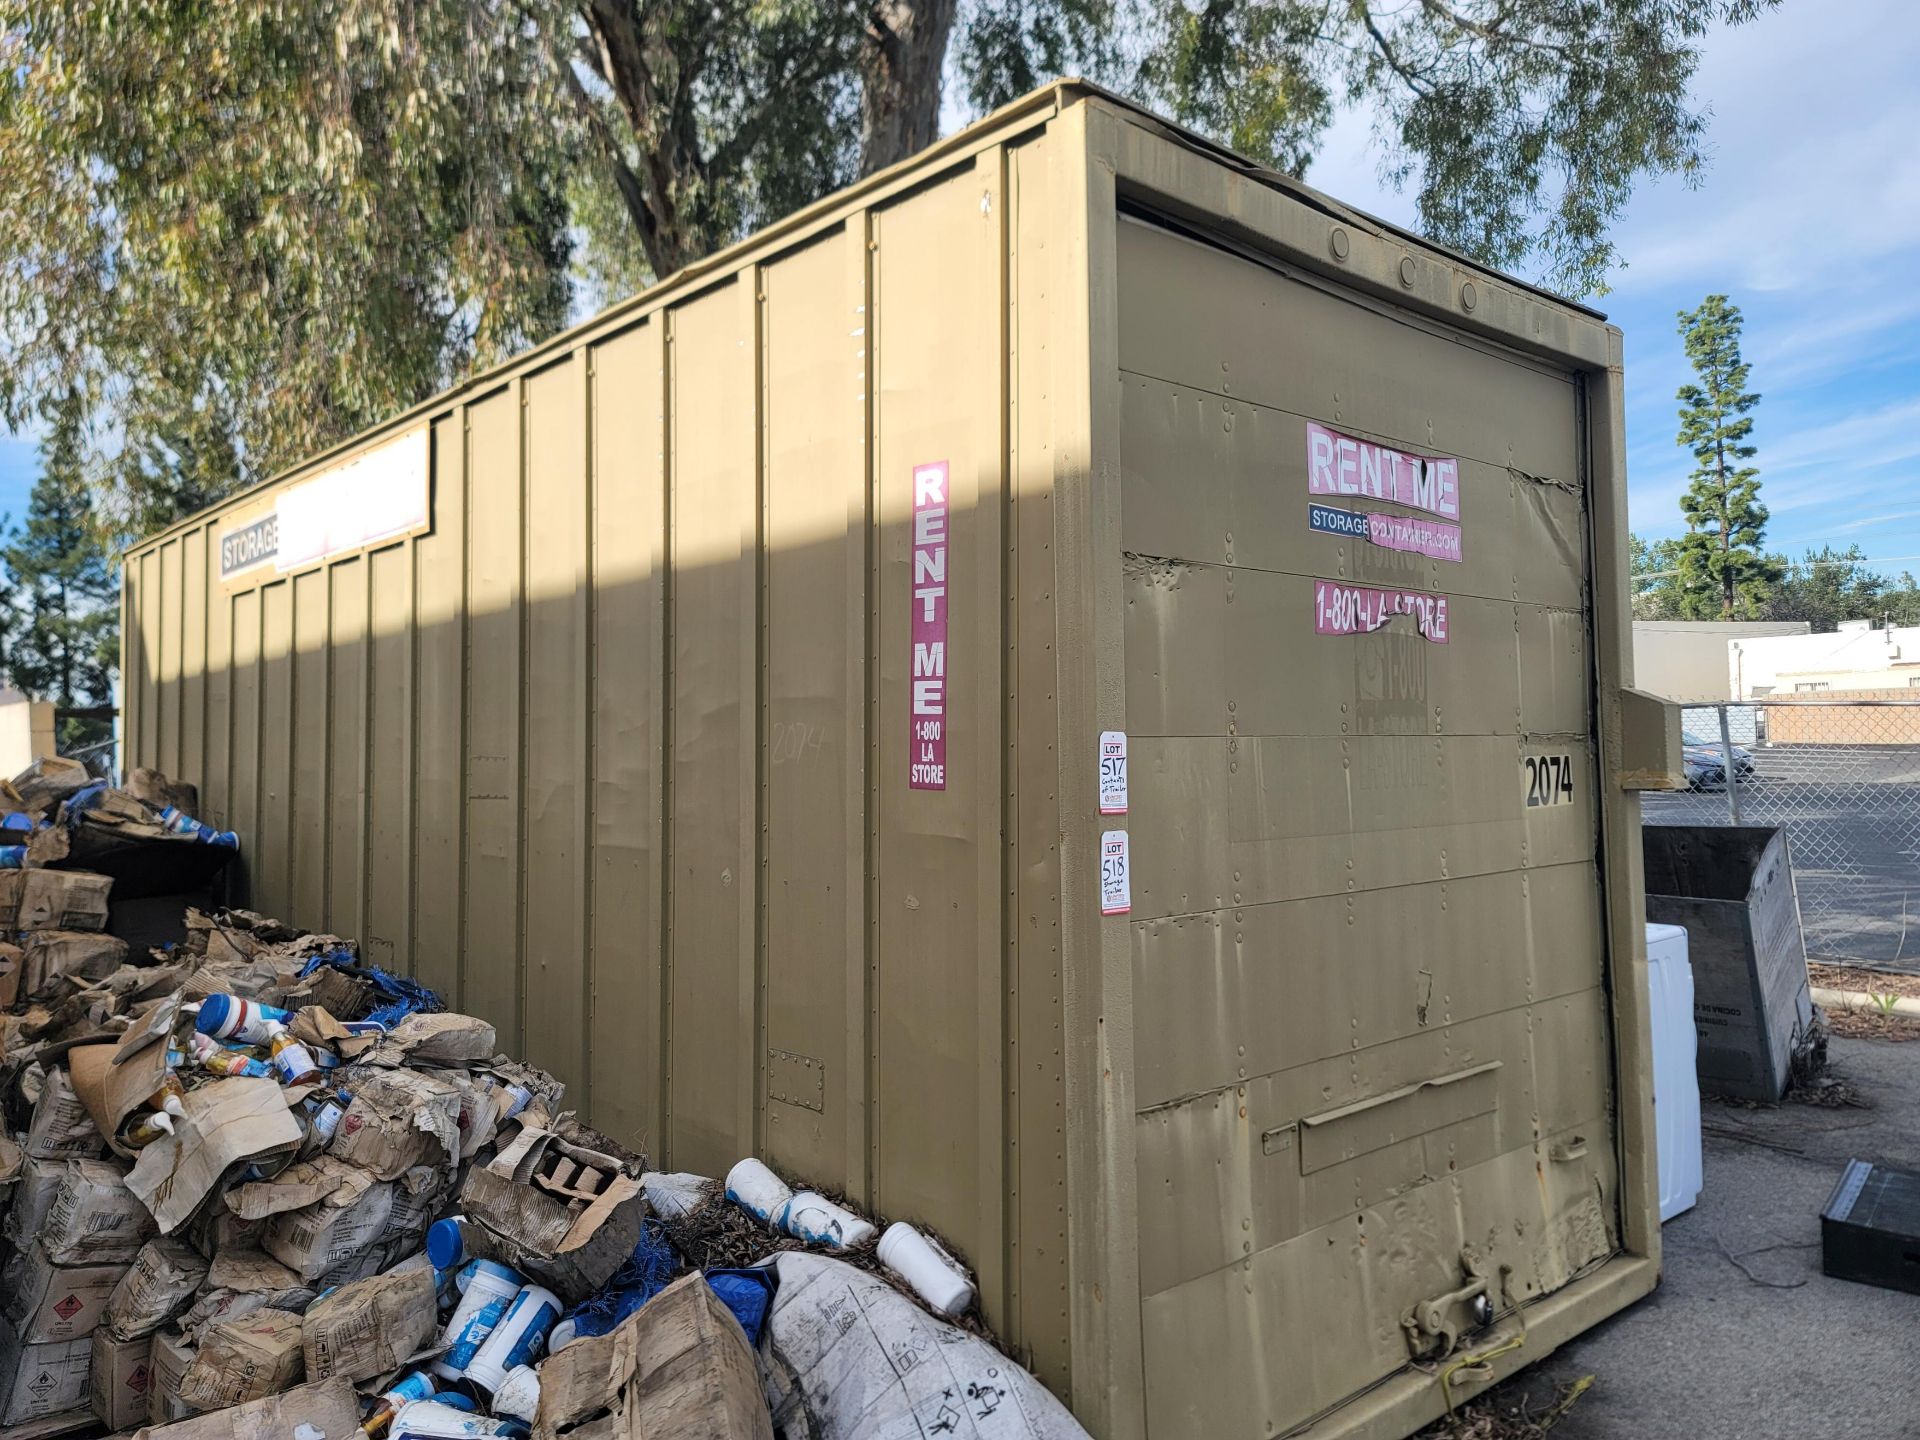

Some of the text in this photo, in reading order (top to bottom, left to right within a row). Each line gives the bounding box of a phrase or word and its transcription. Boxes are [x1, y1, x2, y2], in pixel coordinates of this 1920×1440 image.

[1311, 431, 1457, 514] RENT ME
[223, 520, 278, 569] STORAGE
[914, 469, 945, 714] RENT ME
[915, 721, 941, 741] 1-800
[921, 743, 935, 762] LA
[1105, 745, 1121, 754] LOT
[912, 764, 944, 784] STORE
[1101, 757, 1126, 776] 517
[1526, 755, 1573, 807] 2074
[1107, 844, 1122, 854] LOT
[1103, 856, 1125, 881] 518
